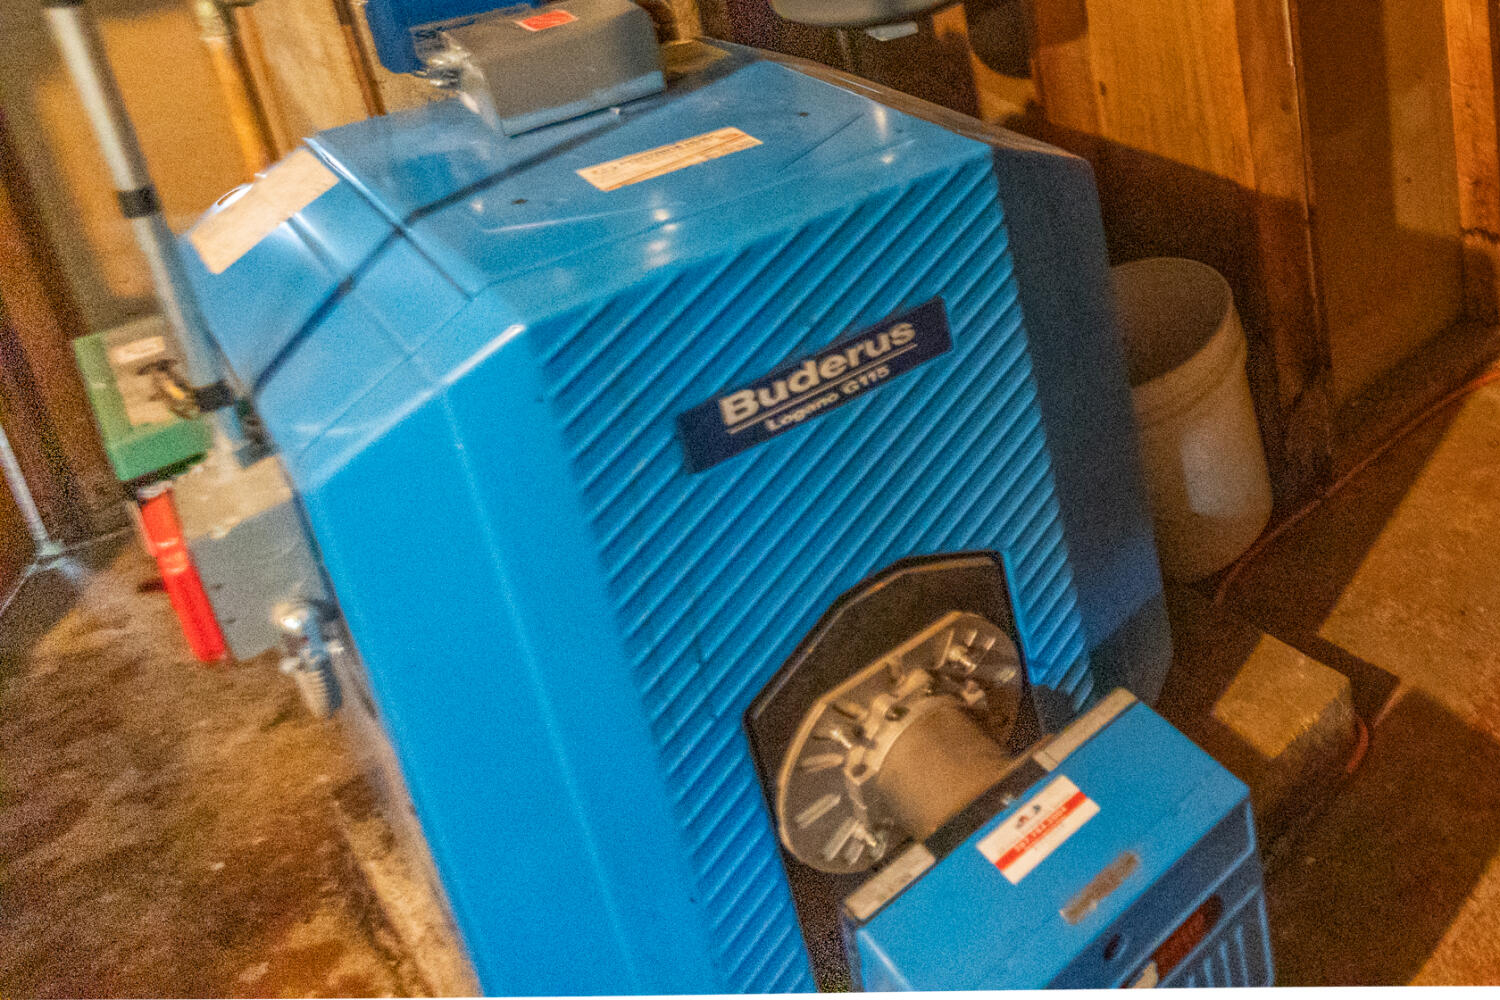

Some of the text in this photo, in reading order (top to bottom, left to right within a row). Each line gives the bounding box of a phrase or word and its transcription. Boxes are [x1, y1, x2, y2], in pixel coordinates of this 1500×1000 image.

[719, 322, 917, 426] Buderus
[764, 364, 891, 431] Logano G115
